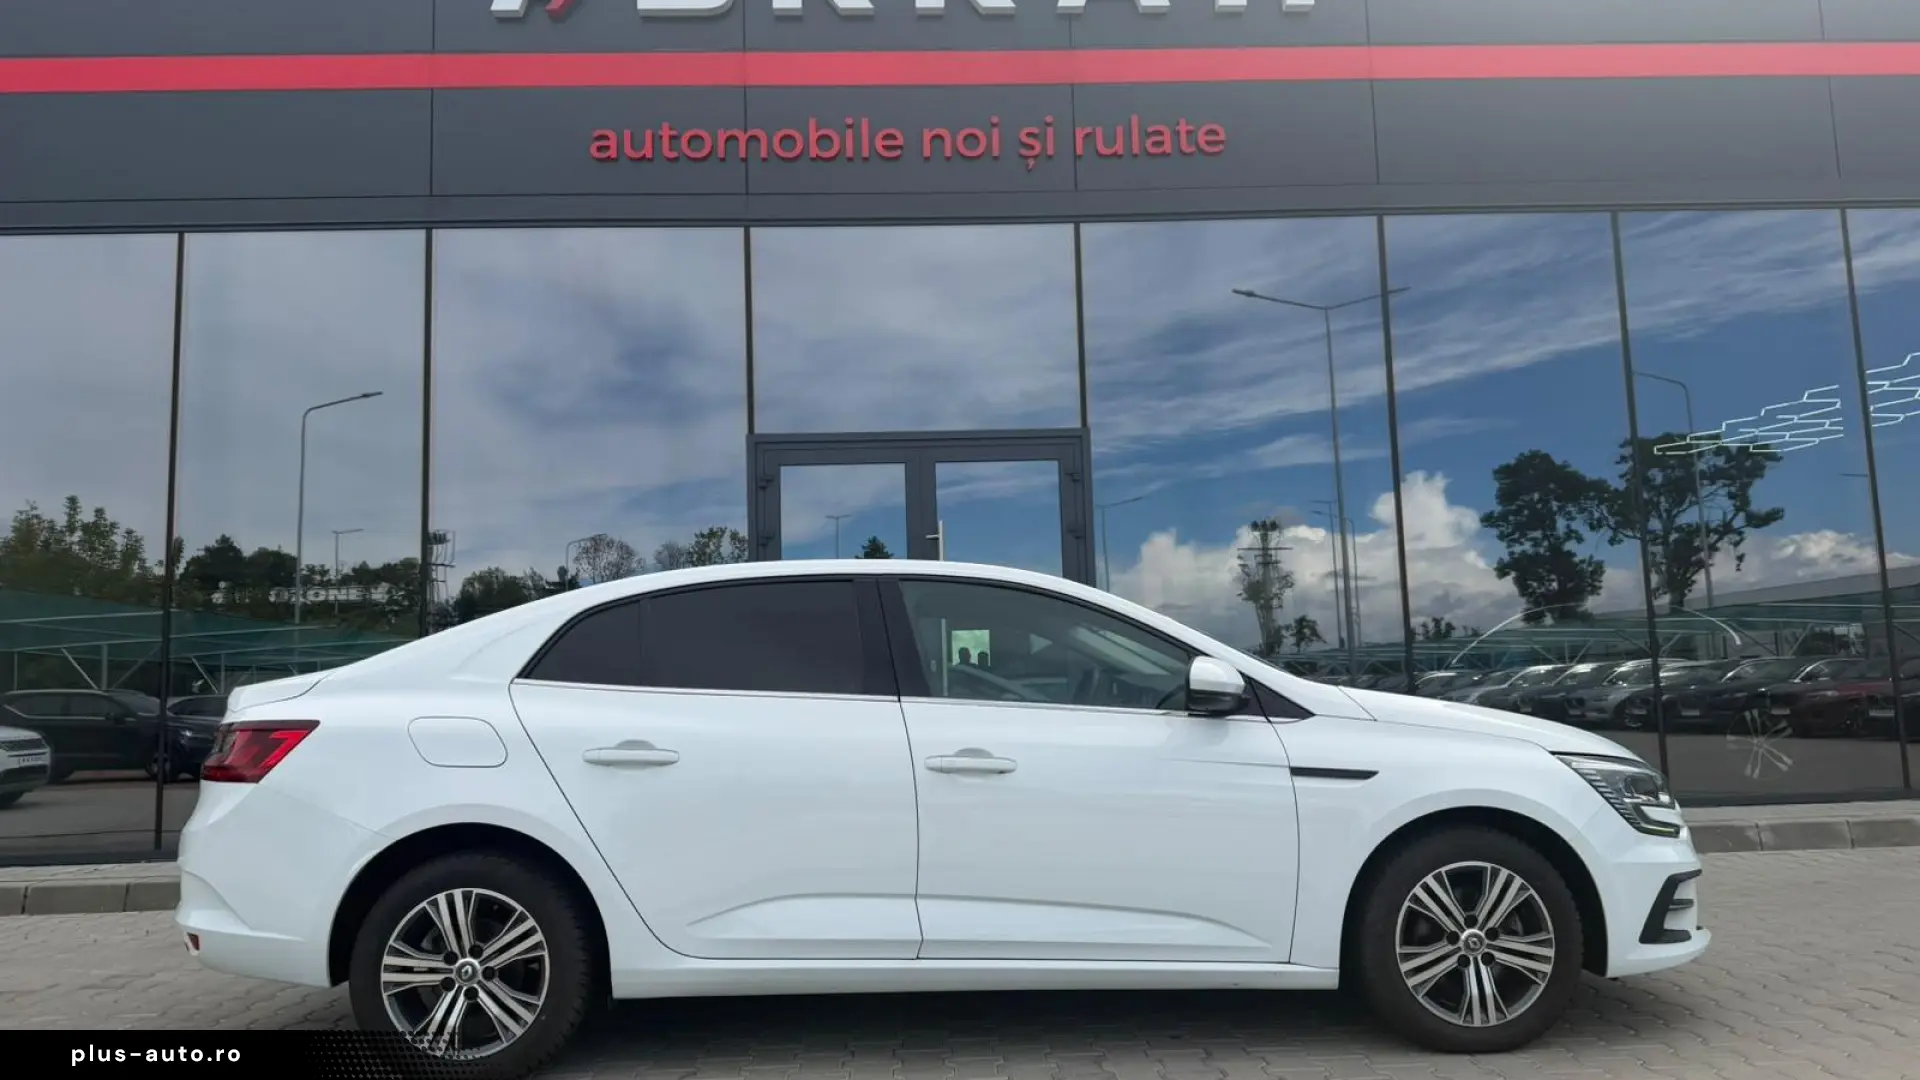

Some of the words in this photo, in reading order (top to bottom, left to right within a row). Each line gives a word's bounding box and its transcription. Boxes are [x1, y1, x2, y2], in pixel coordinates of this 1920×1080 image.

[589, 117, 905, 162] automobile
[922, 115, 1000, 161] noi
[1018, 115, 1055, 172] și
[1074, 113, 1227, 158] rulate
